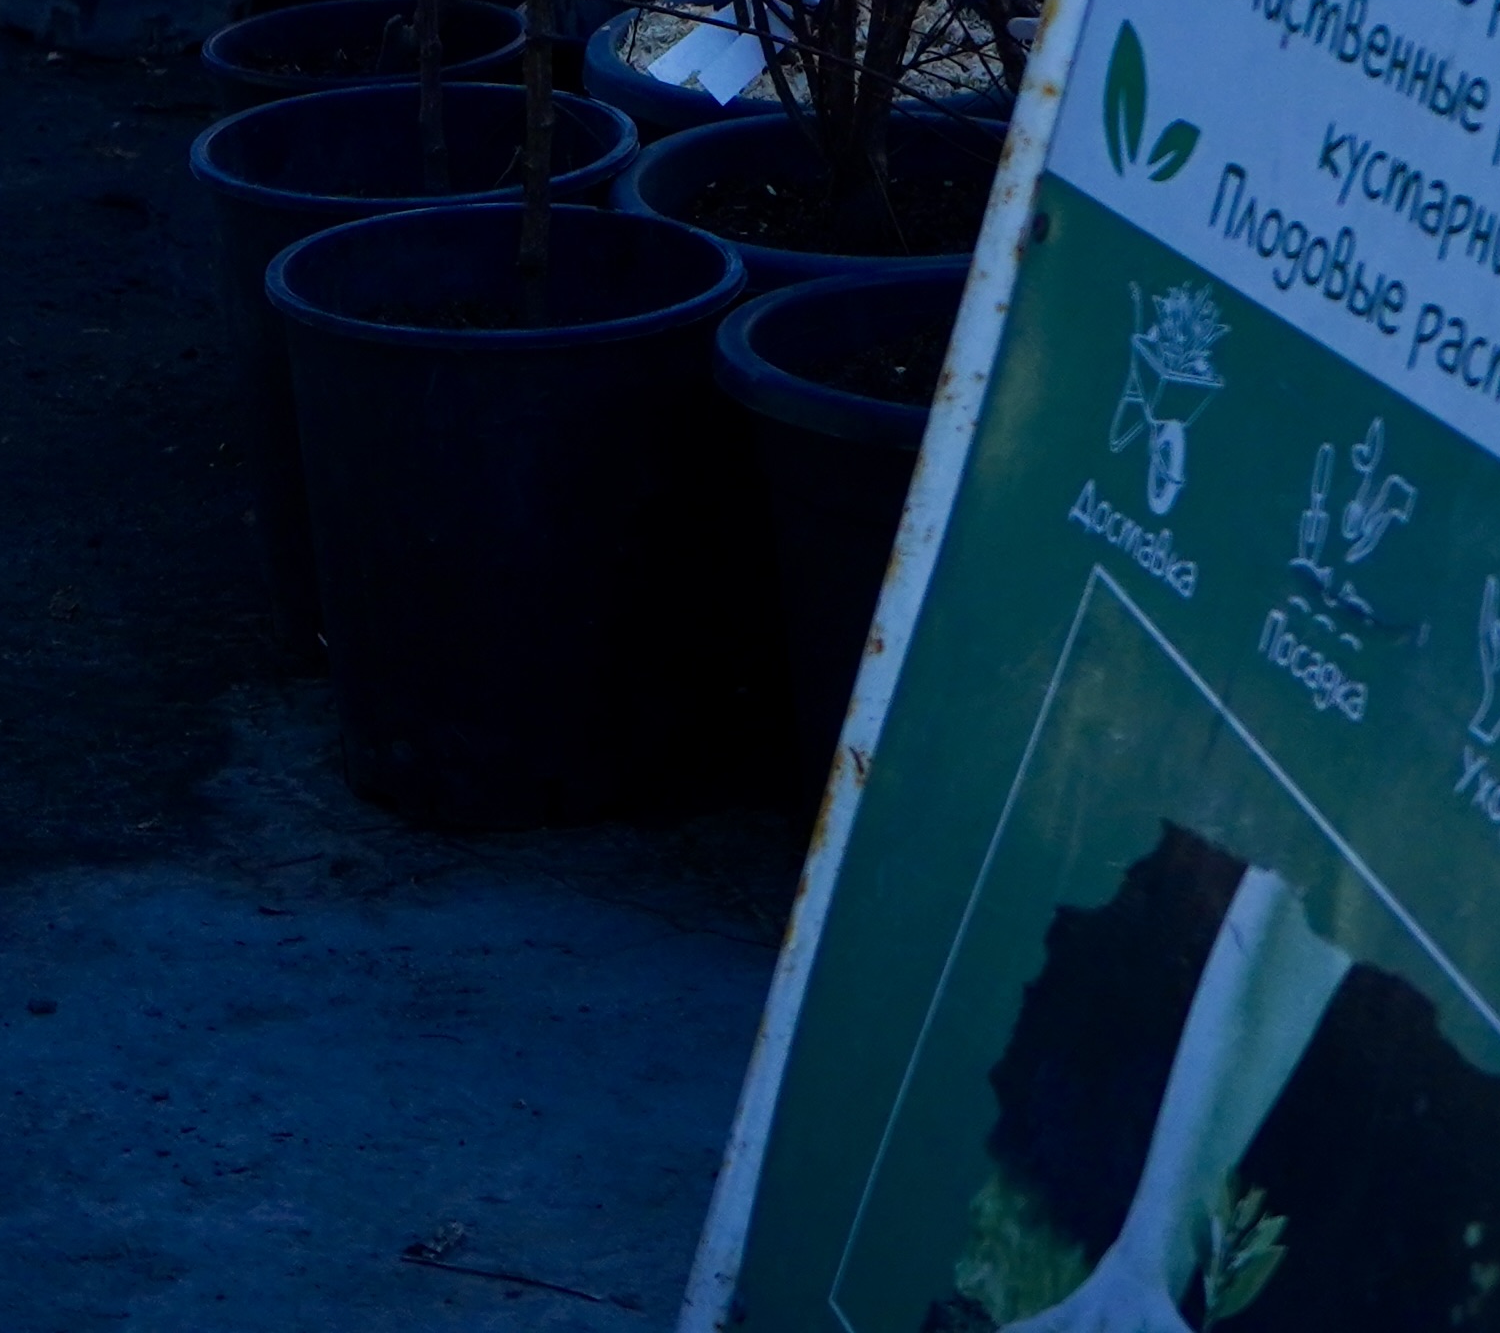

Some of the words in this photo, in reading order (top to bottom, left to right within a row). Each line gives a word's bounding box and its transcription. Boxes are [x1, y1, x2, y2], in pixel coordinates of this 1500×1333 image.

[1209, 163, 1404, 336] Плодовые
[1068, 481, 1195, 597] Доставка
[1260, 610, 1367, 720] Посадка
